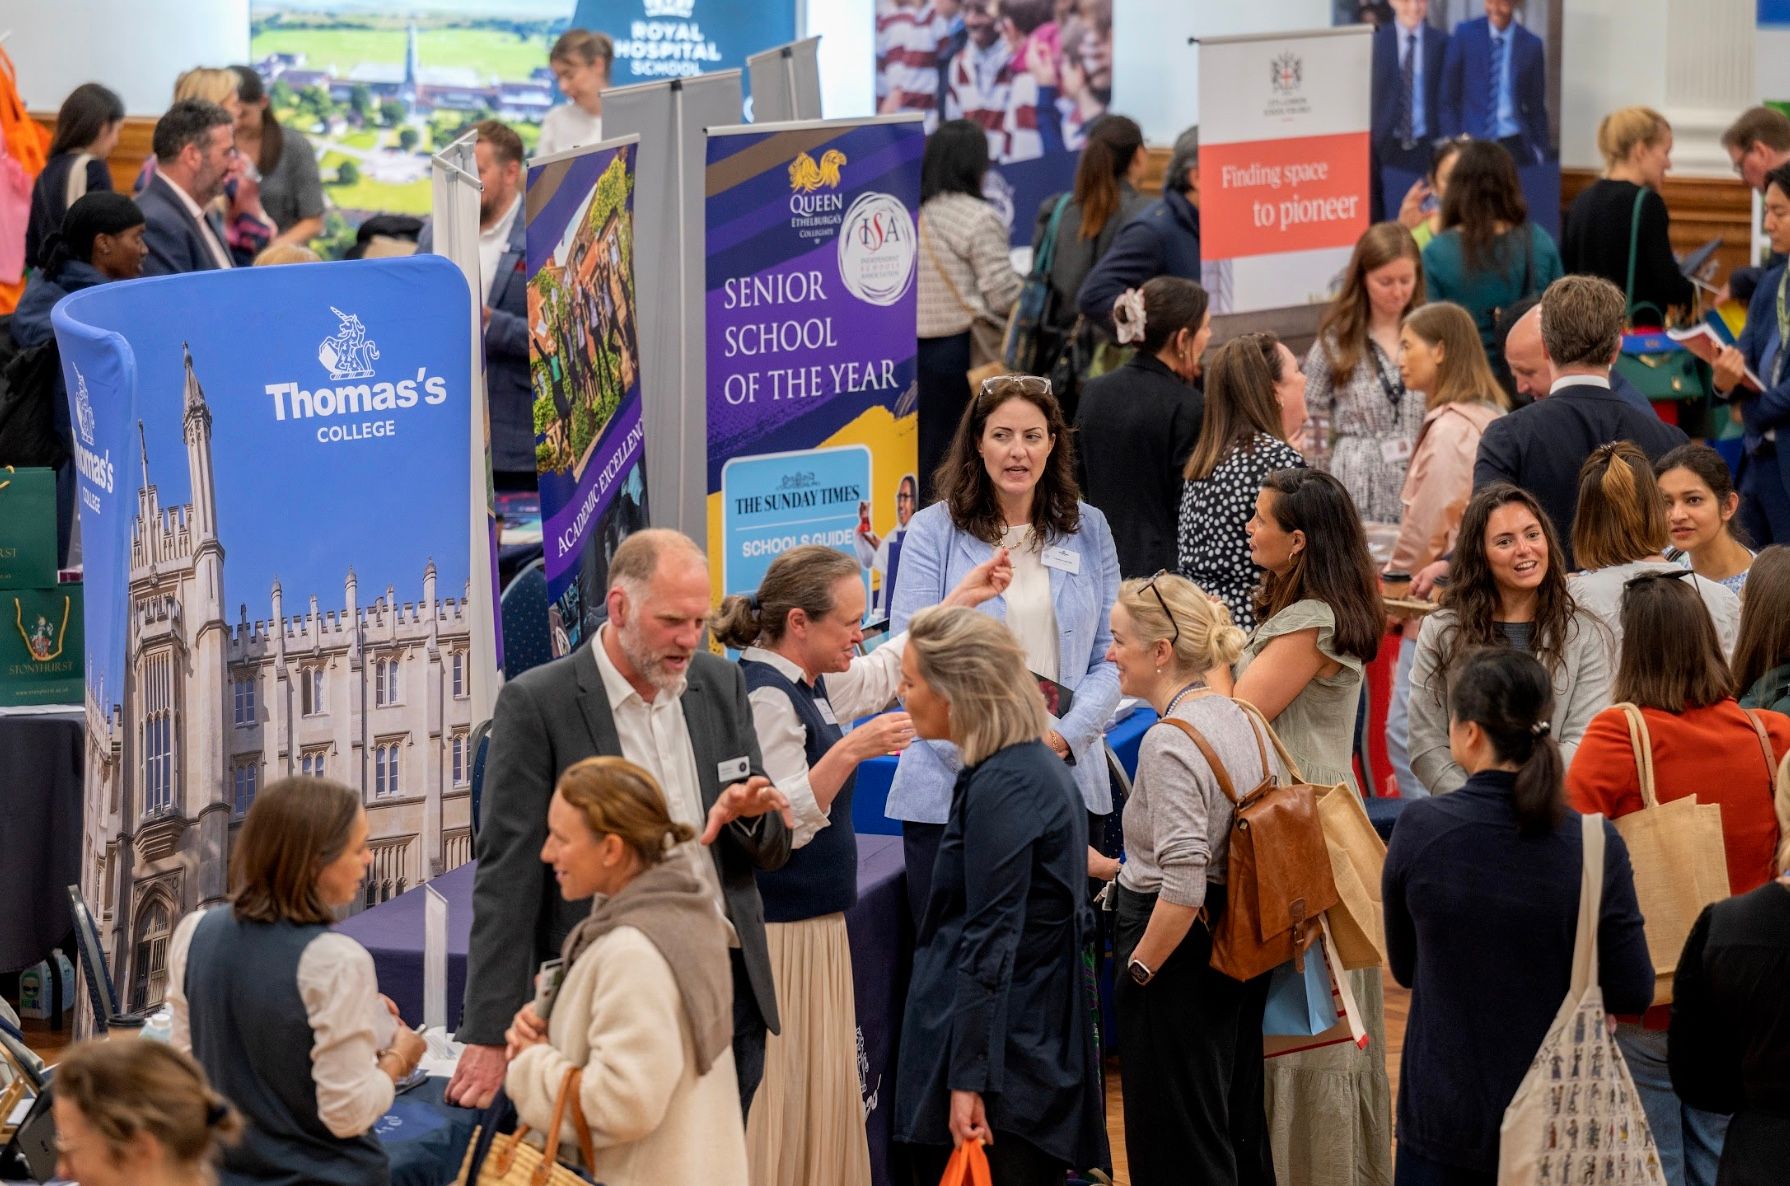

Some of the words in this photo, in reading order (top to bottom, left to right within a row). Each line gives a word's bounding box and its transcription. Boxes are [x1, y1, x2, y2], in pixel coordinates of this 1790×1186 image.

[630, 20, 705, 42] ROYAL
[613, 39, 722, 62] HOSPITAL
[630, 59, 704, 77] SCHOOL
[1221, 163, 1282, 189] Finding
[1284, 161, 1329, 187] space
[789, 193, 843, 217] QUEEN
[1253, 199, 1276, 228] to
[1280, 194, 1359, 232] pioneer
[859, 211, 900, 251] ISA
[724, 271, 828, 309] SENIOR
[725, 317, 838, 357] SCHOOL
[265, 367, 447, 421] Thomas's
[724, 372, 760, 405] OF
[767, 366, 823, 400] THE
[829, 359, 899, 394] YEAR
[317, 420, 396, 443] COLLEGE
[557, 483, 600, 558] ACADEMIC
[599, 418, 644, 496] EXCELLENC
[736, 495, 763, 515] THE
[764, 489, 818, 512] SUNDAY
[820, 484, 860, 505] TIMES
[812, 529, 853, 547] GUIDE
